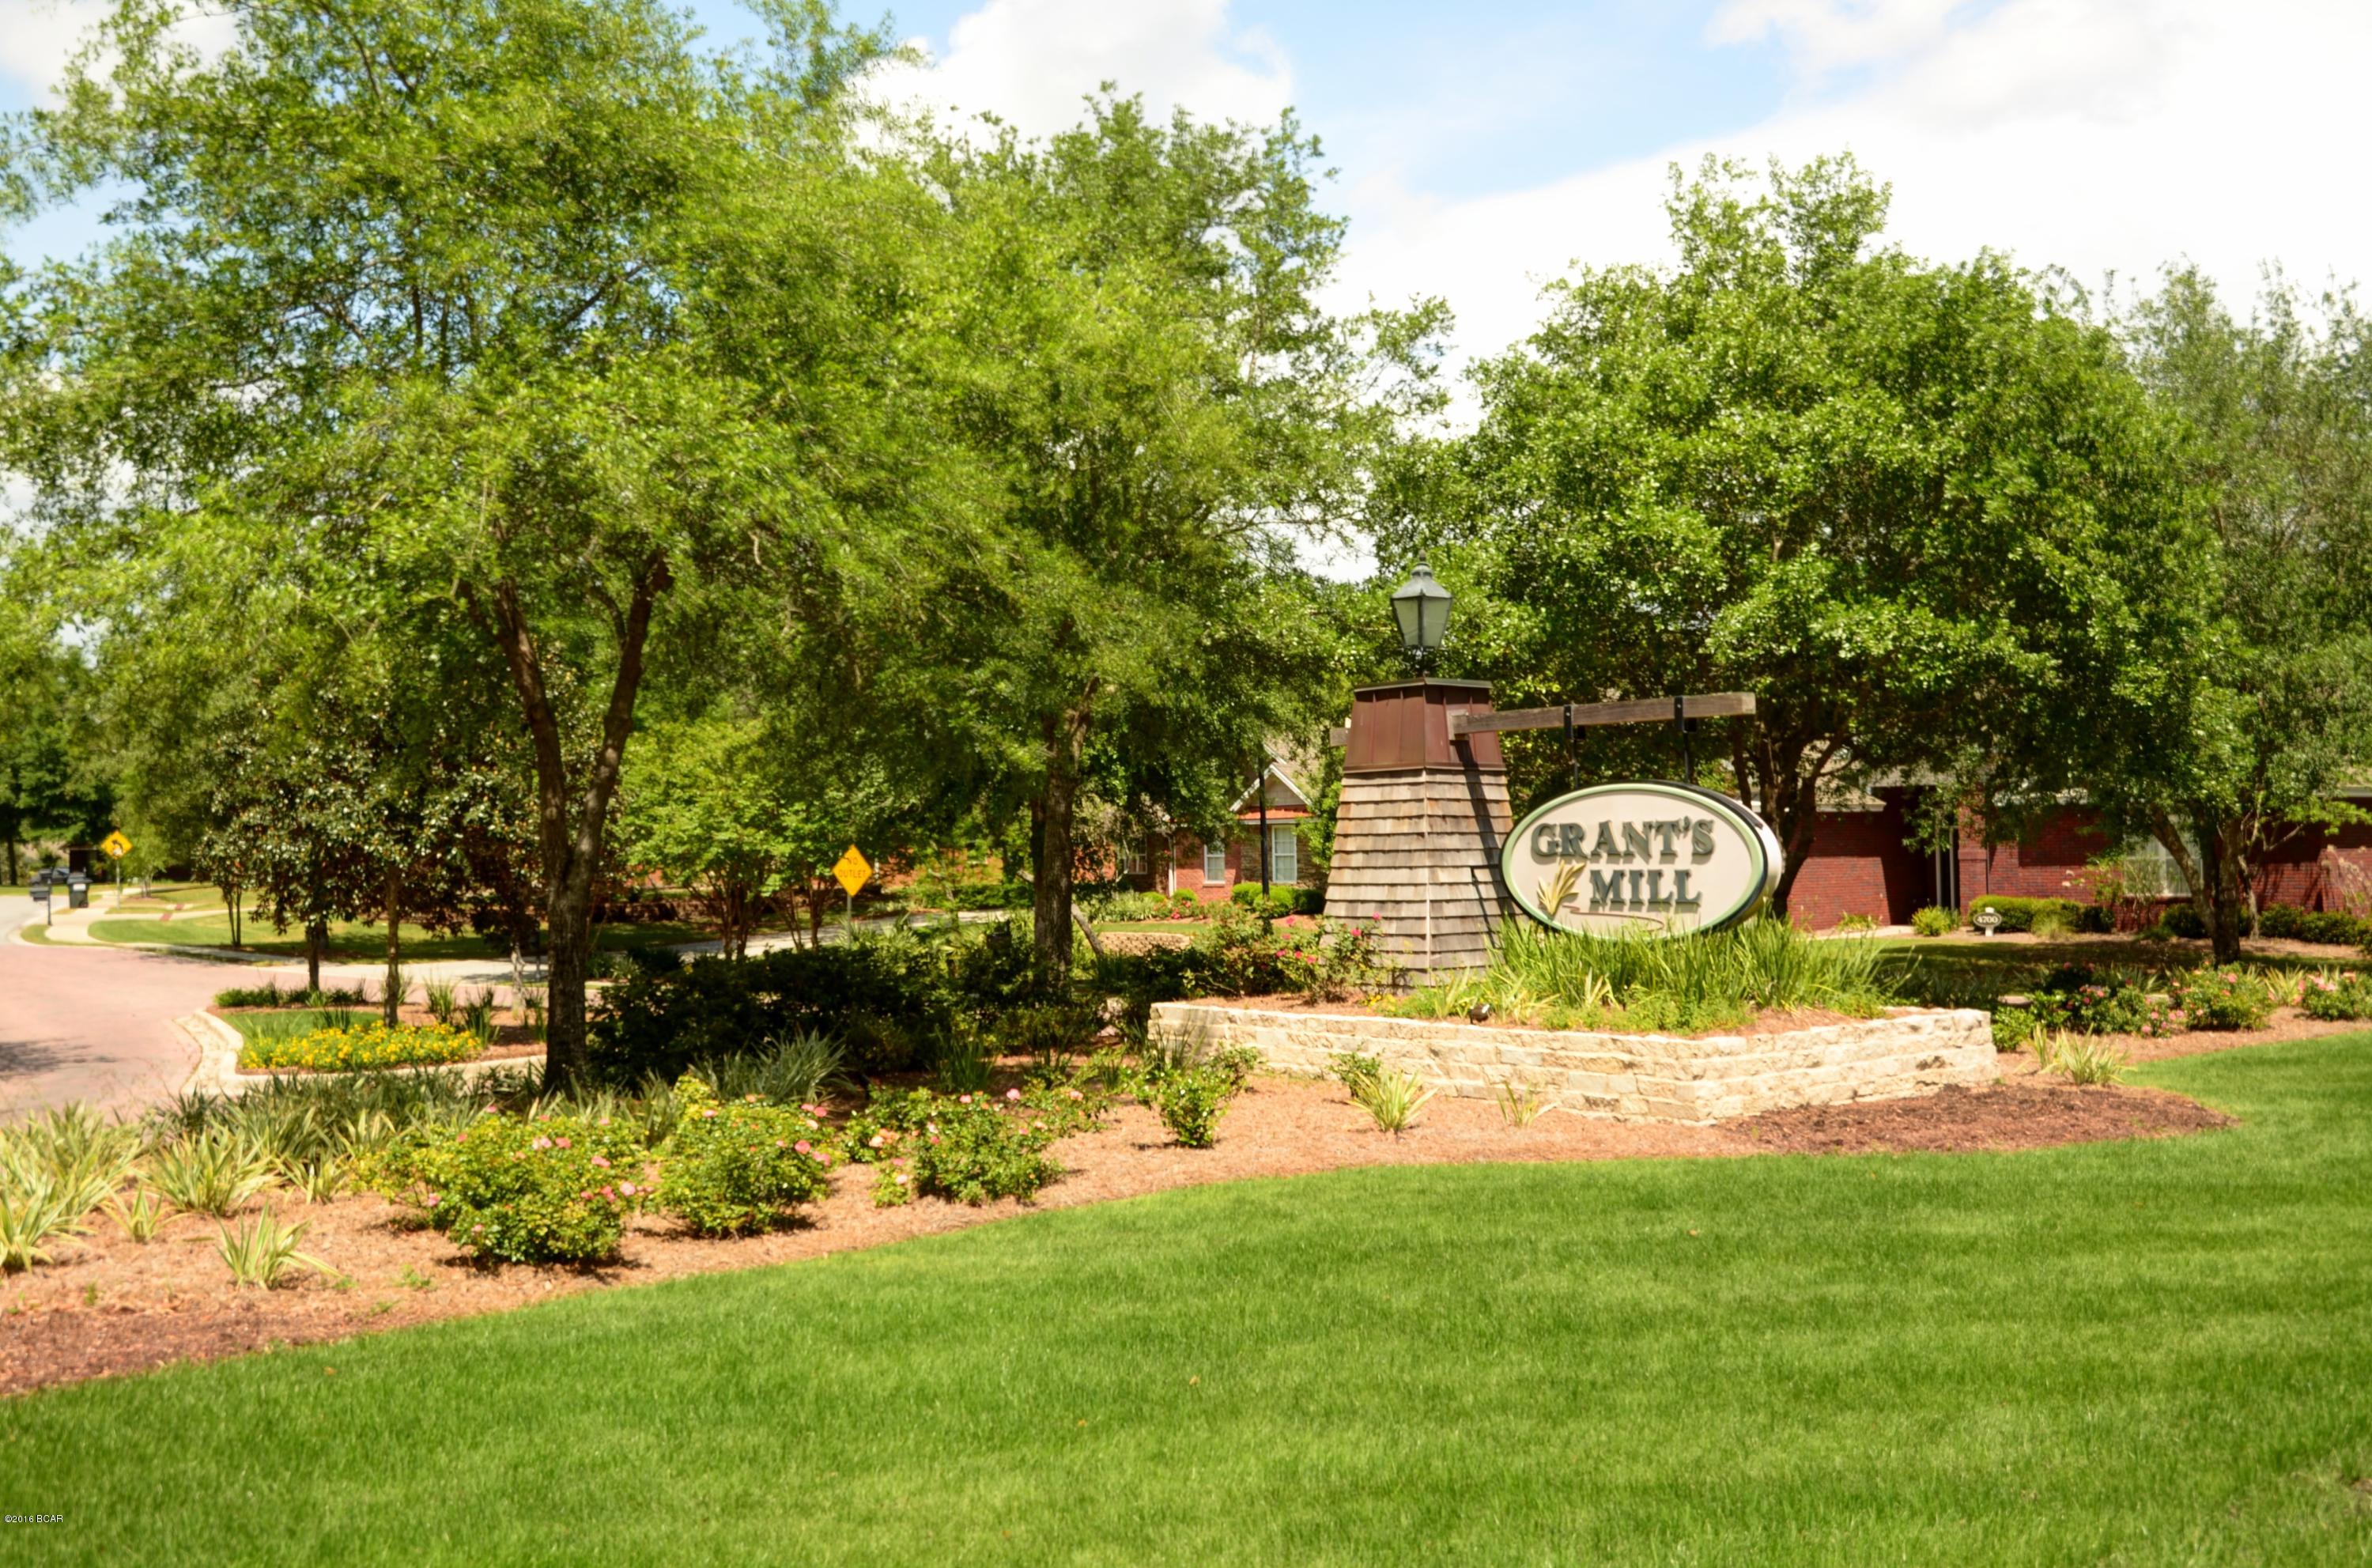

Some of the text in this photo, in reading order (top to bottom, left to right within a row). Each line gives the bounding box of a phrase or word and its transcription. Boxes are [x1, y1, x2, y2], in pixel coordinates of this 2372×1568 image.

[1531, 816, 1715, 860] GRANT'S
[848, 856, 859, 866] NO
[838, 869, 867, 878] OUTLET
[1589, 869, 1702, 906] MILL
[1977, 915, 1999, 924] 4700
